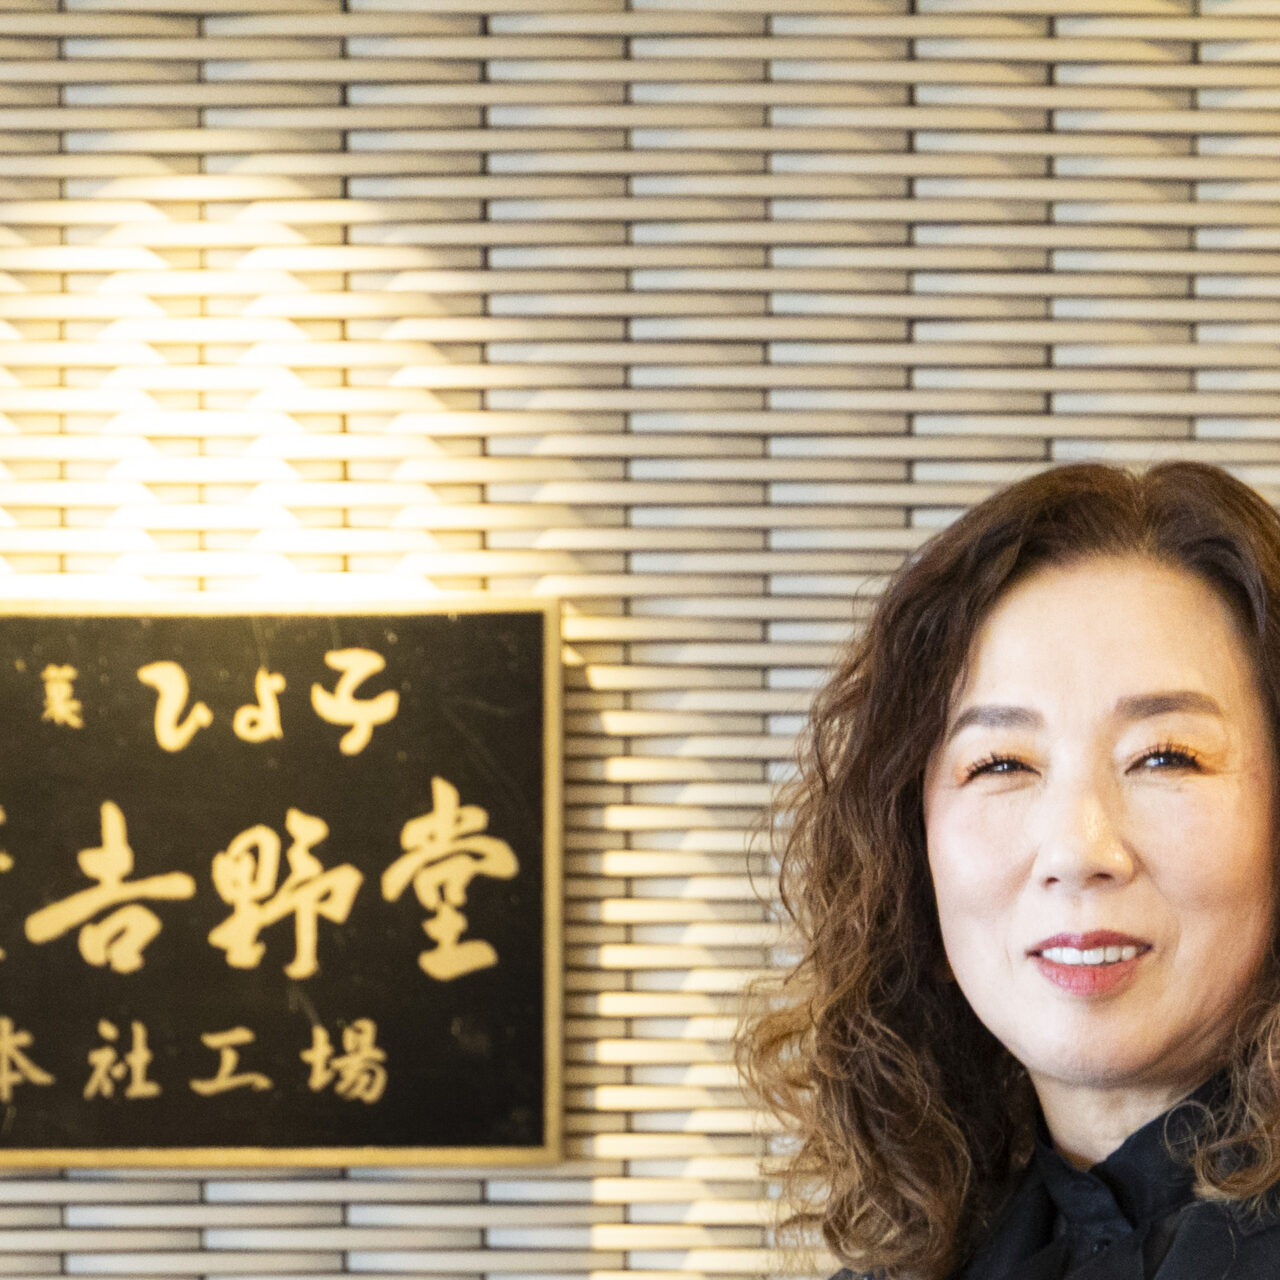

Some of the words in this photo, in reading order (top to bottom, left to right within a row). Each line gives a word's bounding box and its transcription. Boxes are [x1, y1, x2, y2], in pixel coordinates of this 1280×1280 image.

[137, 647, 400, 755] ひよ子
[24, 775, 520, 981] 吉野堂
